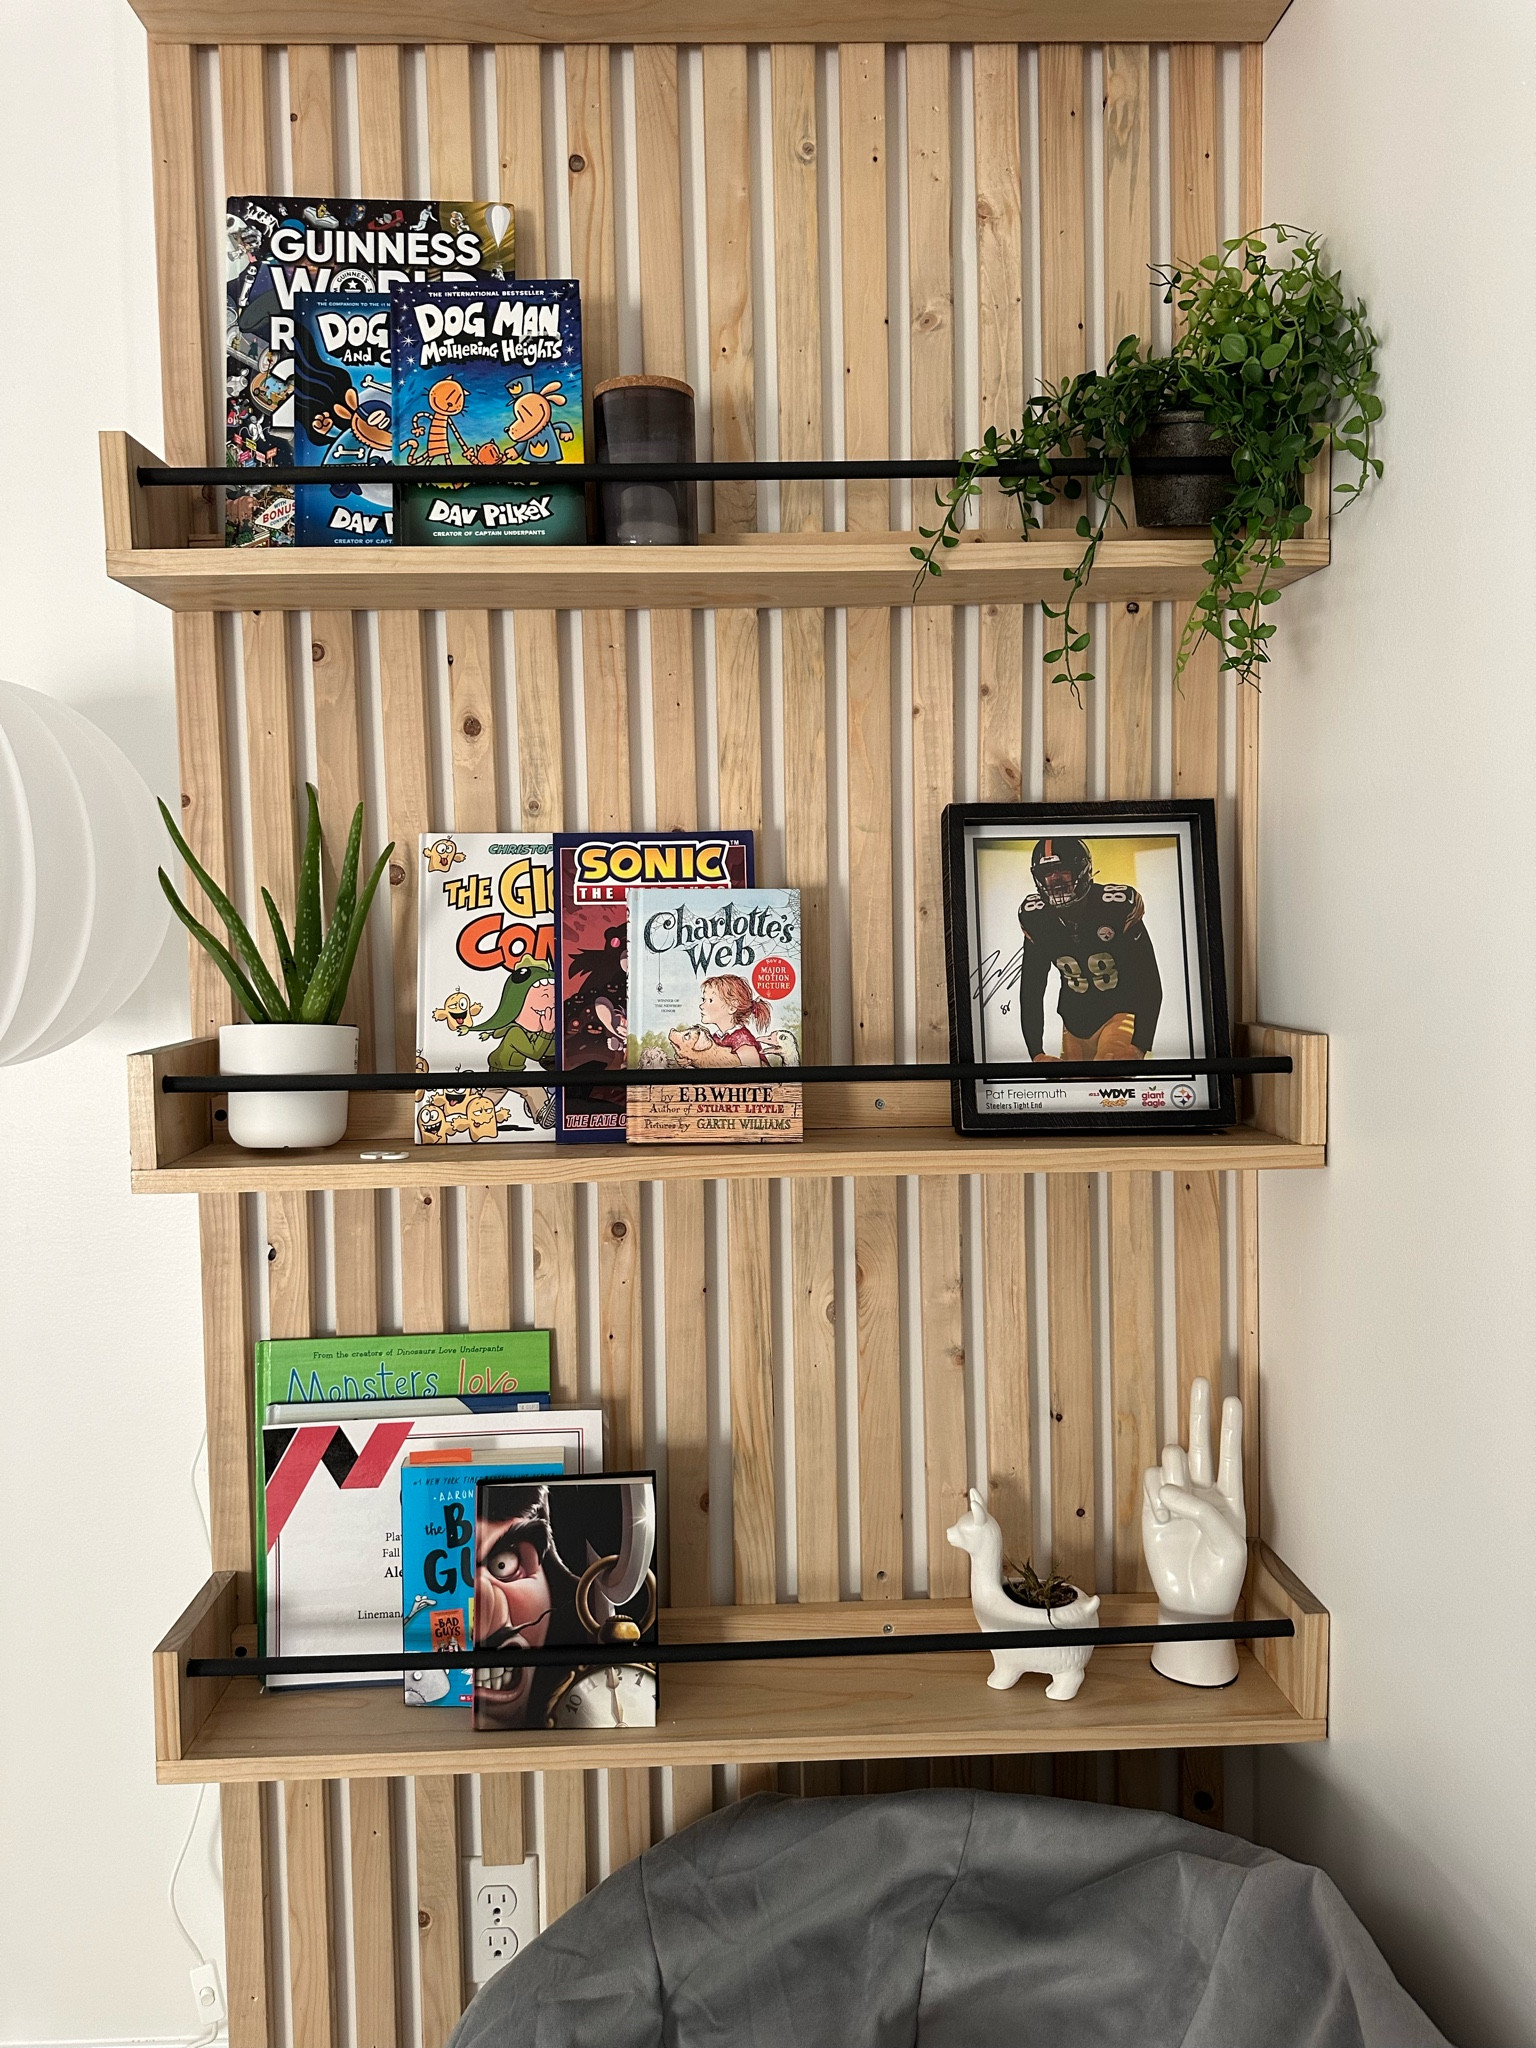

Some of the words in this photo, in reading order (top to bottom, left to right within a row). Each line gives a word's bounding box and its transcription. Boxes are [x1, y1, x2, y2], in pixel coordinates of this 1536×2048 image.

[270, 228, 482, 267] GUINNESS
[336, 271, 369, 283] GUINNESS
[501, 289, 545, 297] BESTSELLER
[413, 301, 486, 343] DOG
[491, 301, 561, 338] MAN
[317, 312, 389, 353] DOG
[273, 500, 287, 509] WITH
[428, 499, 478, 527] DAV
[329, 507, 379, 534] DAV
[580, 843, 726, 882] SONIC
[443, 874, 493, 911] THE
[579, 887, 614, 900] THE
[643, 902, 794, 953] Charlotte's
[760, 966, 787, 974] MAJOR
[757, 974, 790, 982] MOTION
[661, 1087, 674, 1104] by
[985, 1089, 1004, 1100] Pat
[1007, 1088, 1067, 1099] Freiermuth
[1099, 1088, 1136, 1099] WDVE
[1141, 1091, 1165, 1101] giant
[649, 1104, 680, 1114] Author
[683, 1103, 693, 1115] of
[697, 1104, 741, 1114] STUART
[745, 1104, 785, 1114] LITTLE
[985, 1102, 1012, 1110] Steelers
[1013, 1101, 1030, 1110] Tight
[1030, 1101, 1043, 1109] End
[1141, 1100, 1166, 1108] eagle
[566, 1115, 590, 1128] THE
[590, 1113, 618, 1127] FATE
[644, 1118, 678, 1130] Pictures
[696, 1118, 736, 1130] GARTH
[739, 1118, 791, 1130] WILLIAMS
[313, 1351, 334, 1359] From
[385, 1348, 394, 1356] of
[396, 1347, 436, 1356] Dinosaurs
[438, 1346, 457, 1354] Love
[459, 1345, 504, 1354] Underpants
[287, 1361, 439, 1402] Monsters
[458, 1358, 519, 1396] love
[439, 1489, 474, 1502] AARON
[425, 1522, 445, 1535] the
[382, 1548, 401, 1558] Fall
[438, 1617, 460, 1629] BAD
[434, 1627, 461, 1638] GUYS
